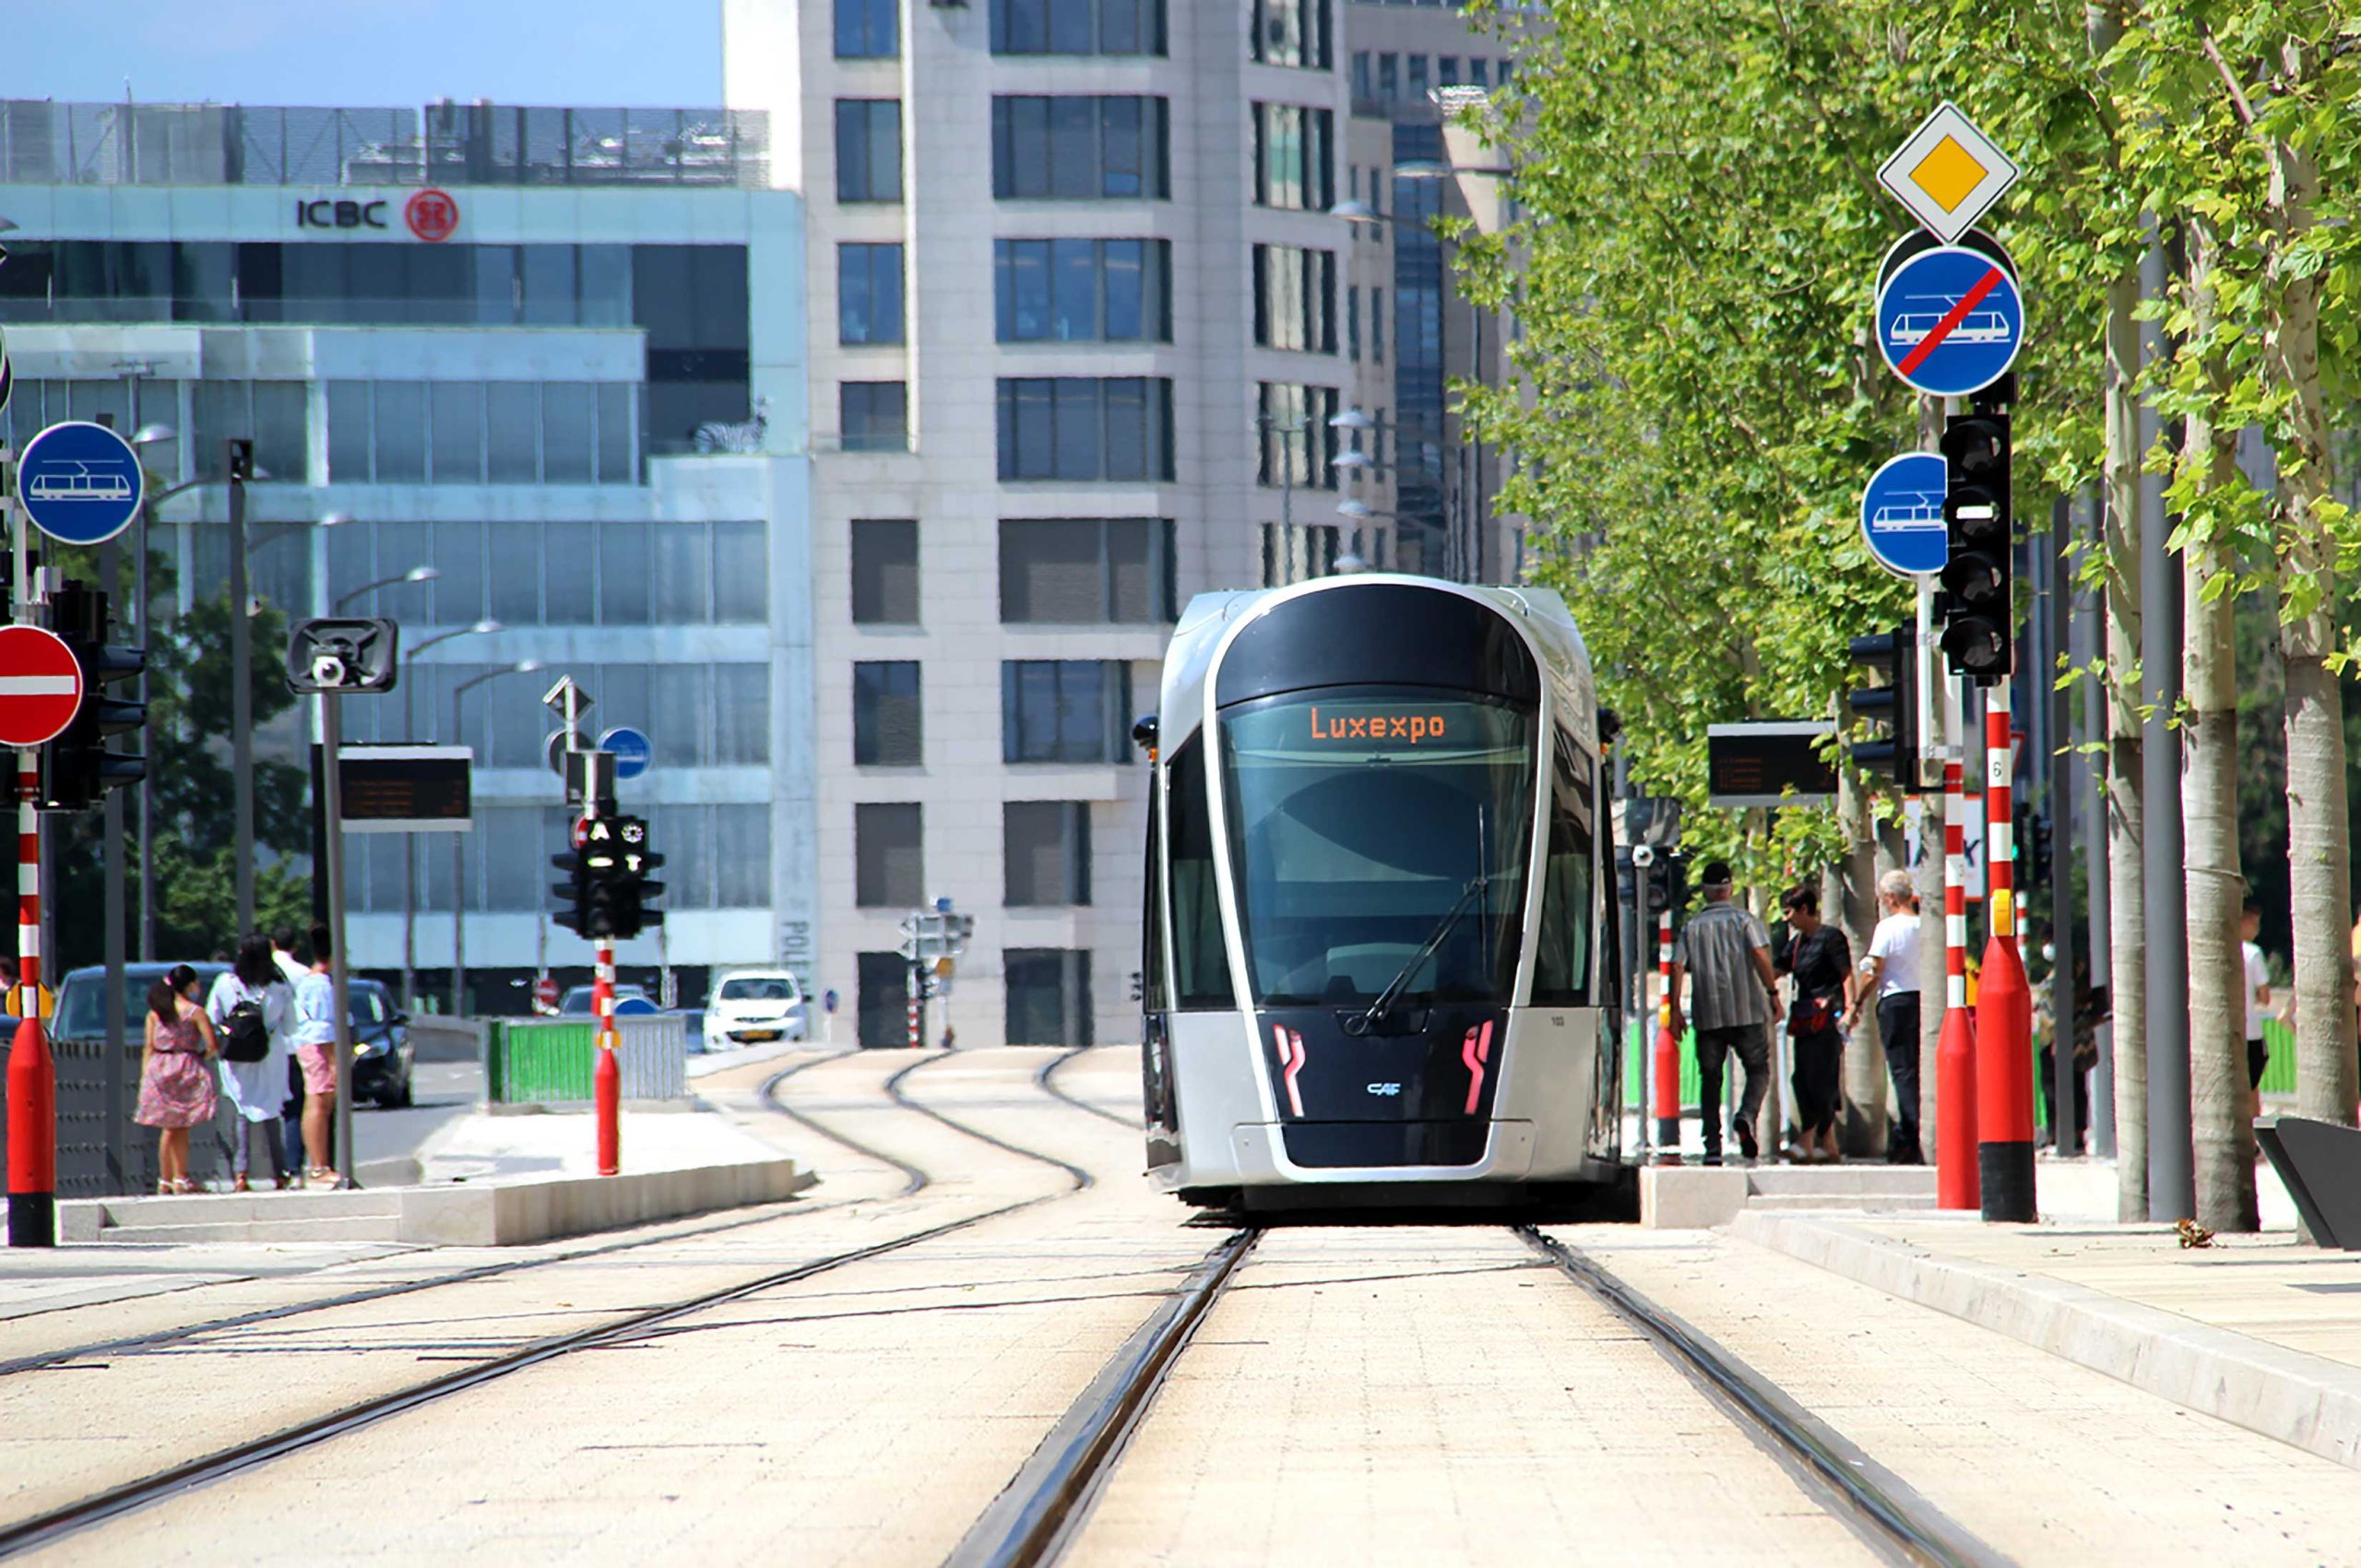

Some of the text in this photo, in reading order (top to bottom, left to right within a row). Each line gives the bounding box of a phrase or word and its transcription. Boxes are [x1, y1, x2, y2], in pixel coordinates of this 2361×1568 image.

[297, 199, 387, 229] ICBC
[1311, 707, 1445, 744] Luxexpo
[1992, 761, 2002, 778] 6
[1367, 1083, 1401, 1096] CAF
